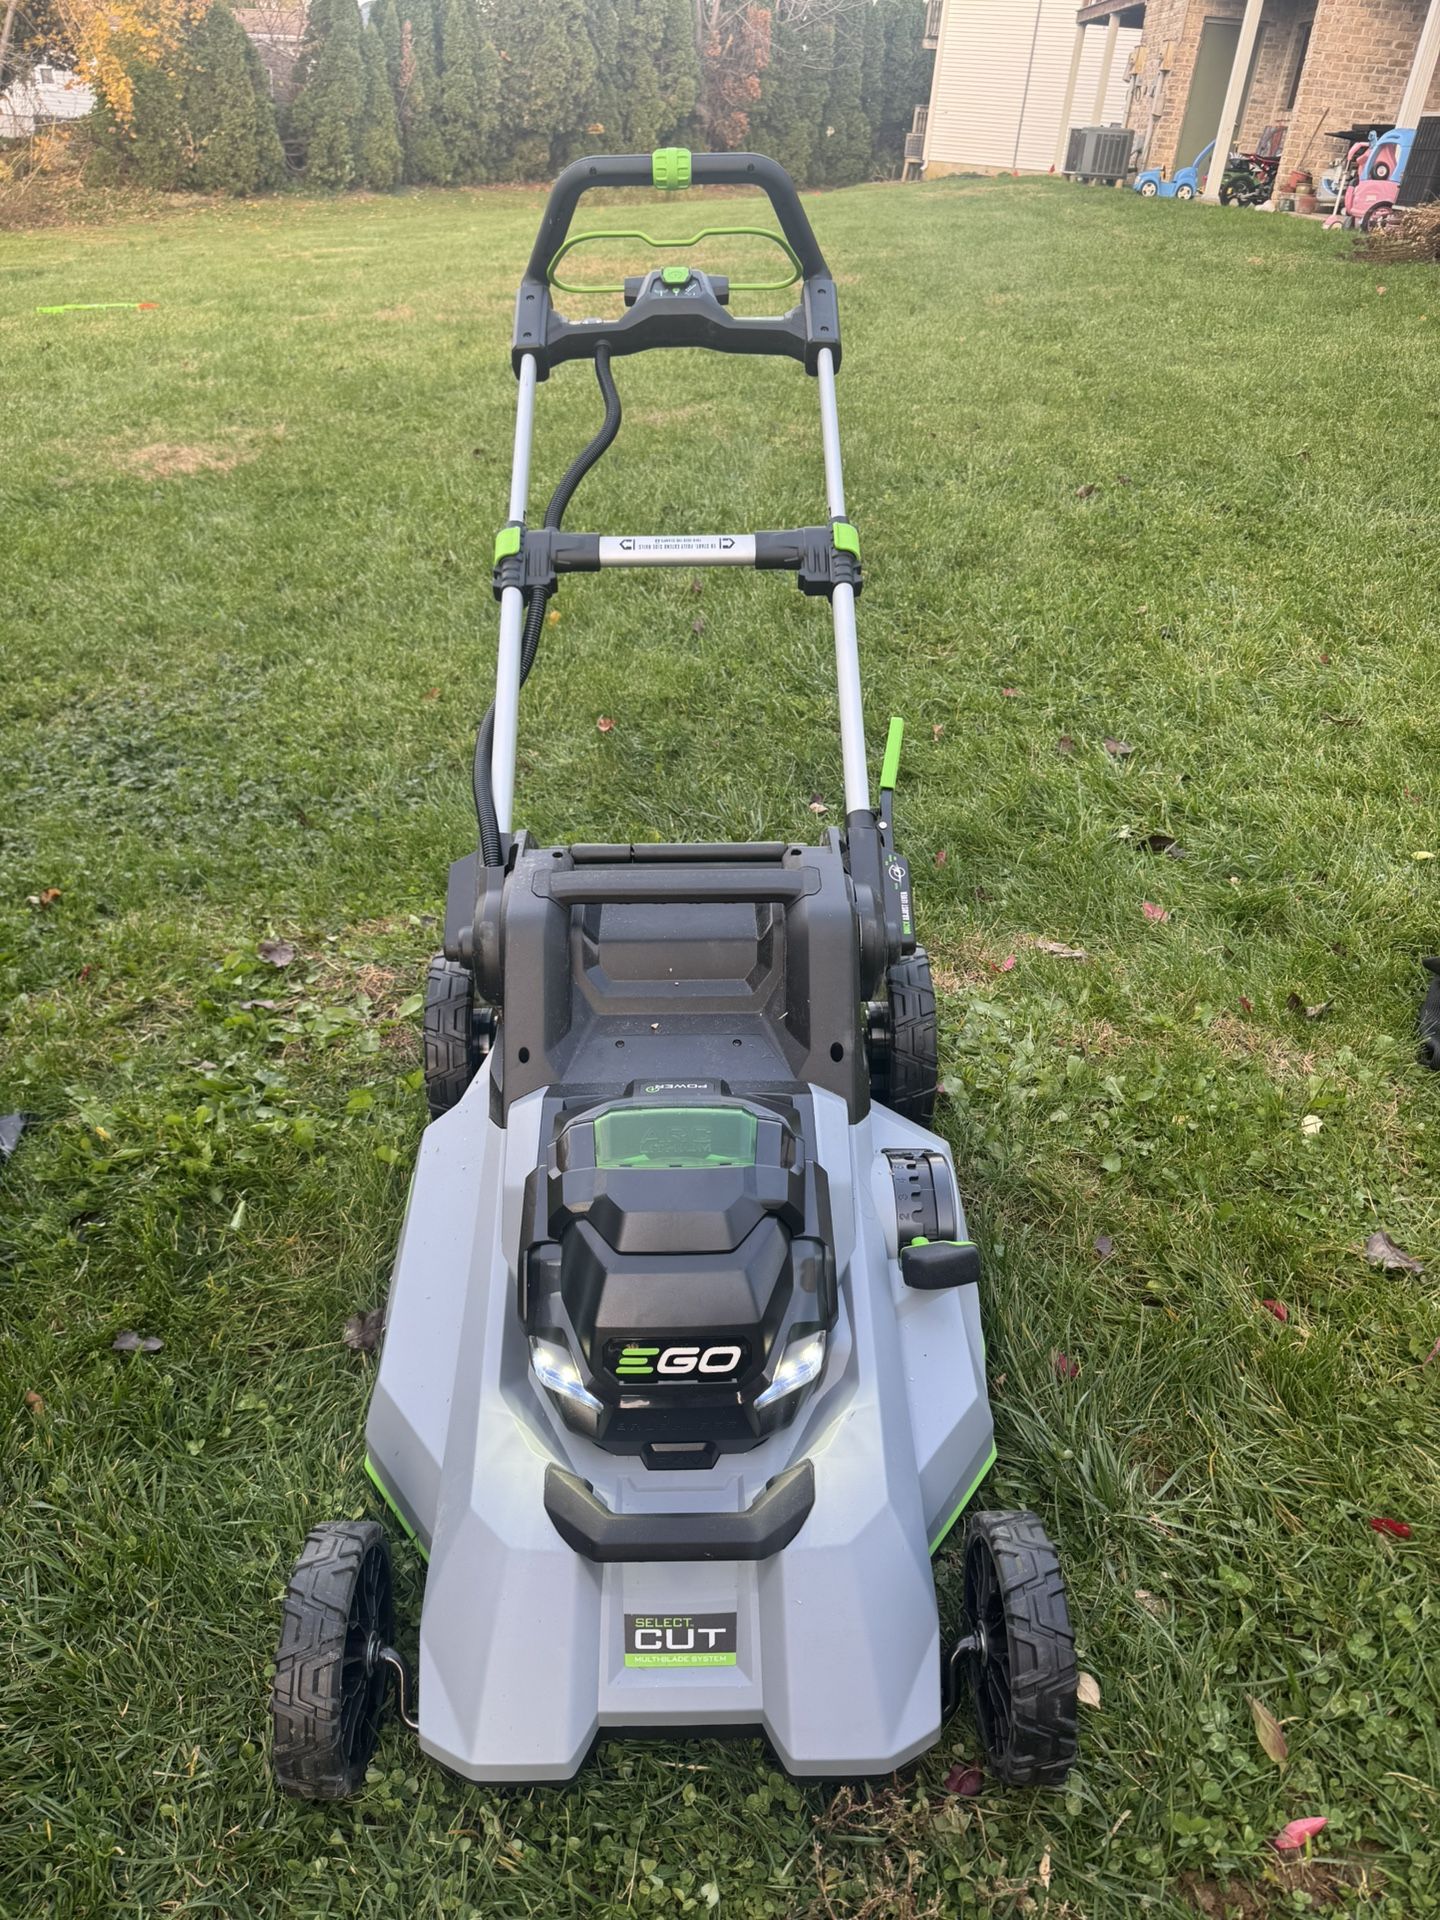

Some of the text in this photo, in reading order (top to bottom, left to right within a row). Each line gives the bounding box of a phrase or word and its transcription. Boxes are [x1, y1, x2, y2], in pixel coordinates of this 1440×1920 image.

[615, 1345, 742, 1374] EGO
[635, 1617, 693, 1628] SELECT
[634, 1628, 727, 1650] CUT
[691, 1655, 727, 1663] SYSTEM
